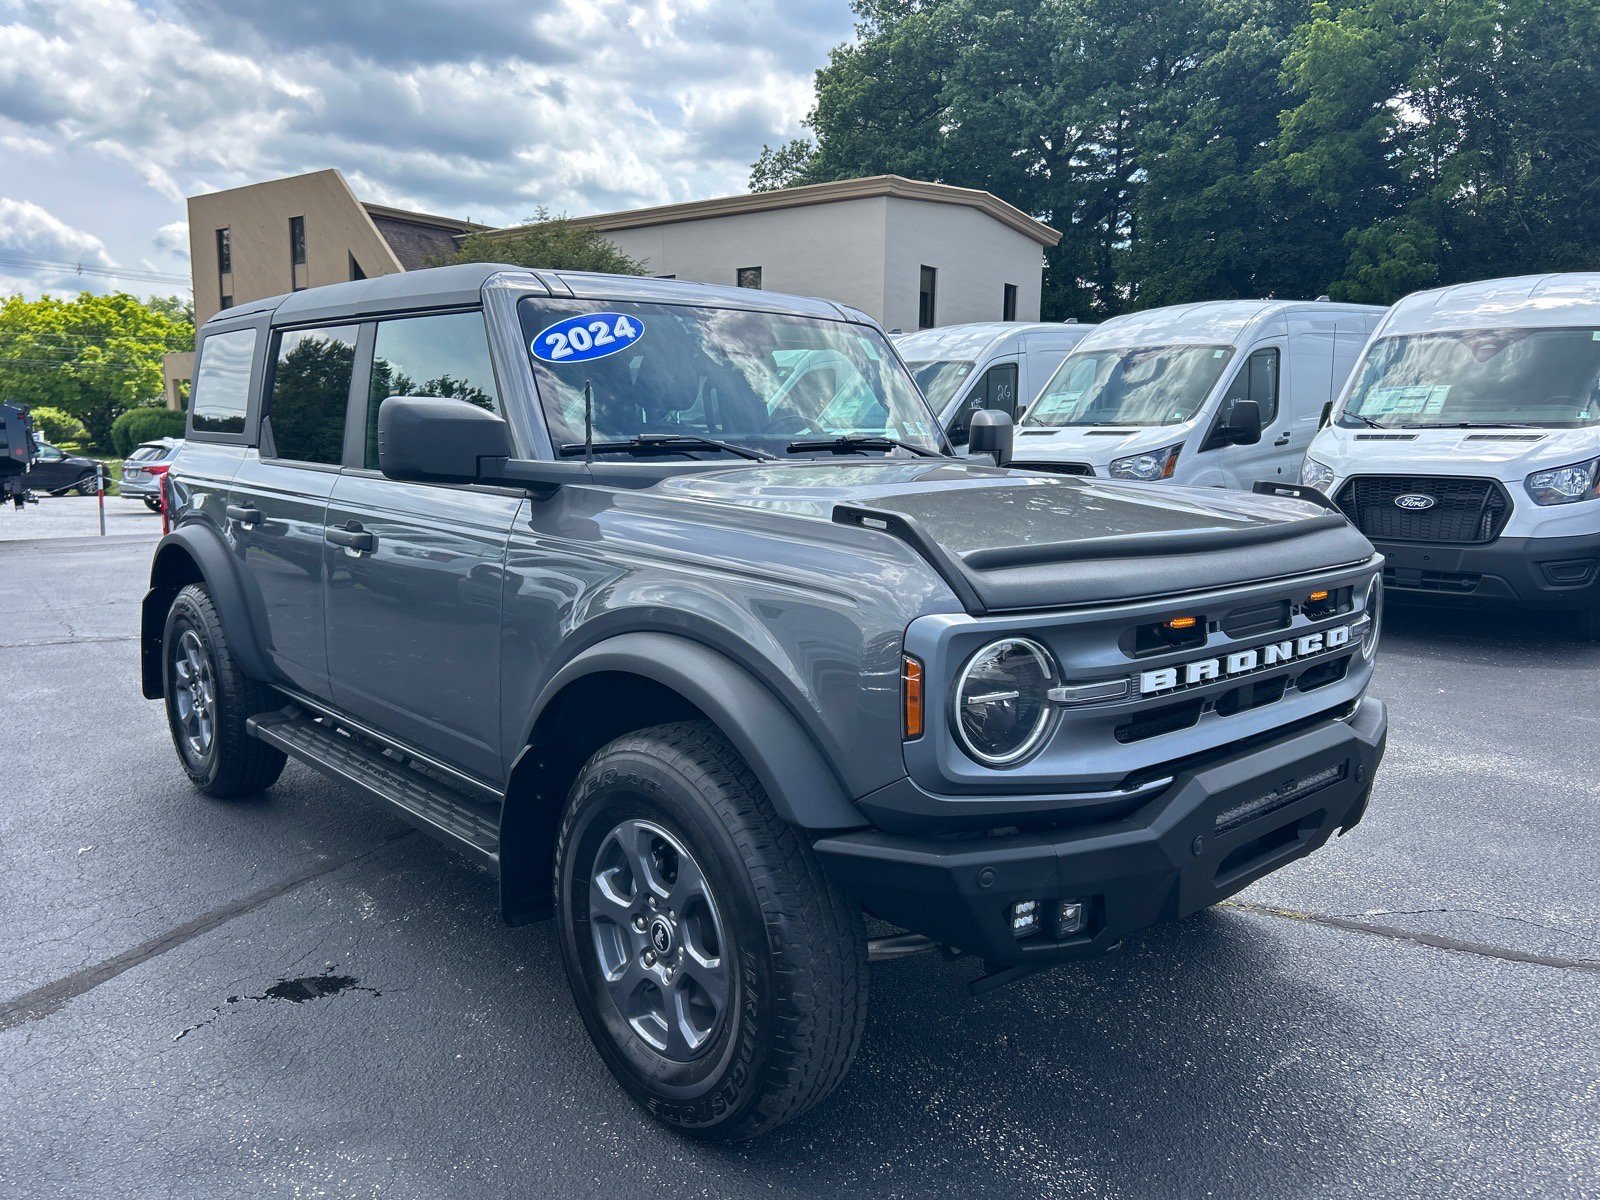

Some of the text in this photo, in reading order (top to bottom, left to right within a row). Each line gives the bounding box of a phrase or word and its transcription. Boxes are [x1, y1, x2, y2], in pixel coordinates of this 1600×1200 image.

[545, 316, 637, 360] 2024
[1401, 496, 1427, 508] Ford
[1140, 625, 1349, 694] BRONCO
